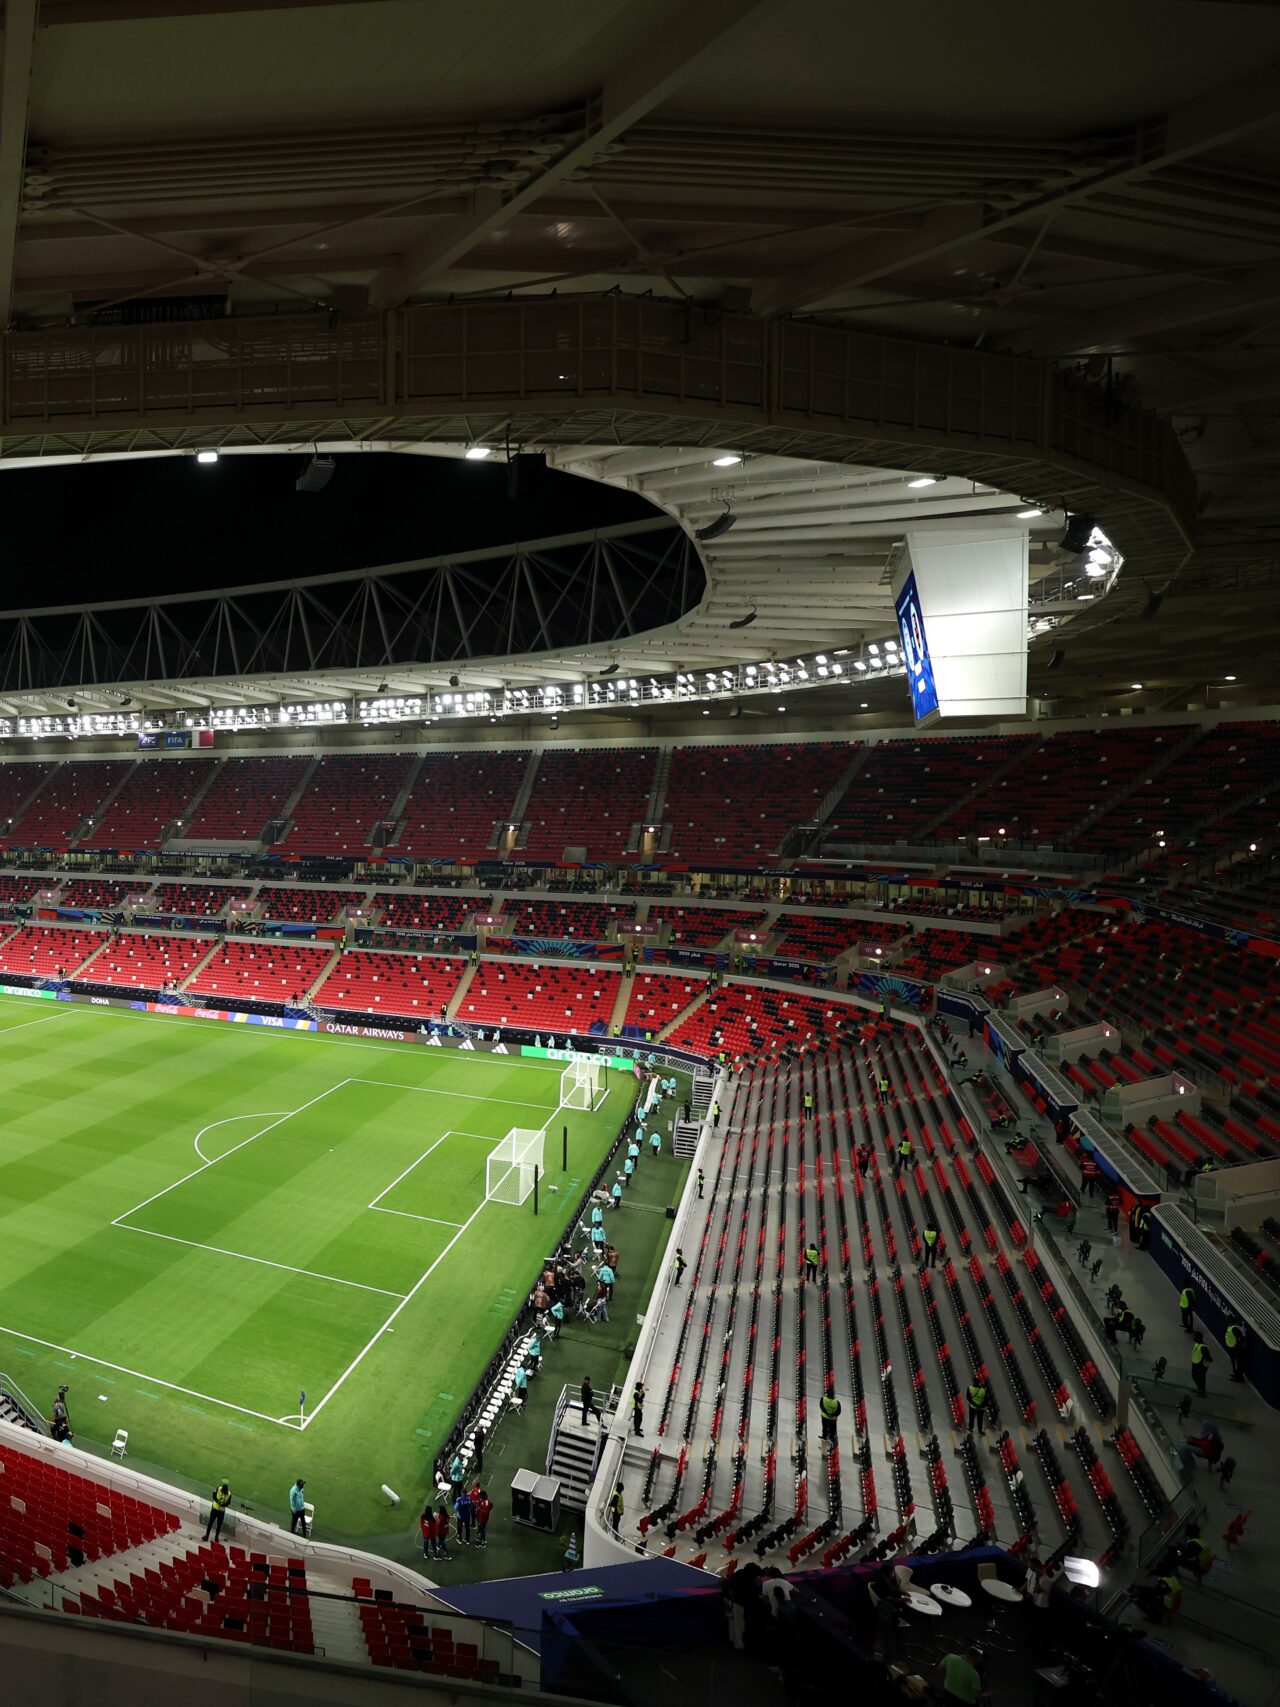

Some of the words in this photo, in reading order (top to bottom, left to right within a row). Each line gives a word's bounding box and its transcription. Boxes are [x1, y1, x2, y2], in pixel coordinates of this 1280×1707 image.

[167, 736, 183, 744] FIFA
[3, 986, 41, 998] aramco
[91, 997, 109, 1005] DOHA
[154, 1004, 178, 1015] Coca-Cola
[194, 1008, 219, 1020] Coca-Cola
[261, 1015, 283, 1027] VISA
[326, 1023, 359, 1035] QATAR
[362, 1026, 404, 1040] AIRWAYS
[546, 1048, 612, 1066] aramco
[543, 1587, 598, 1599] aramco
